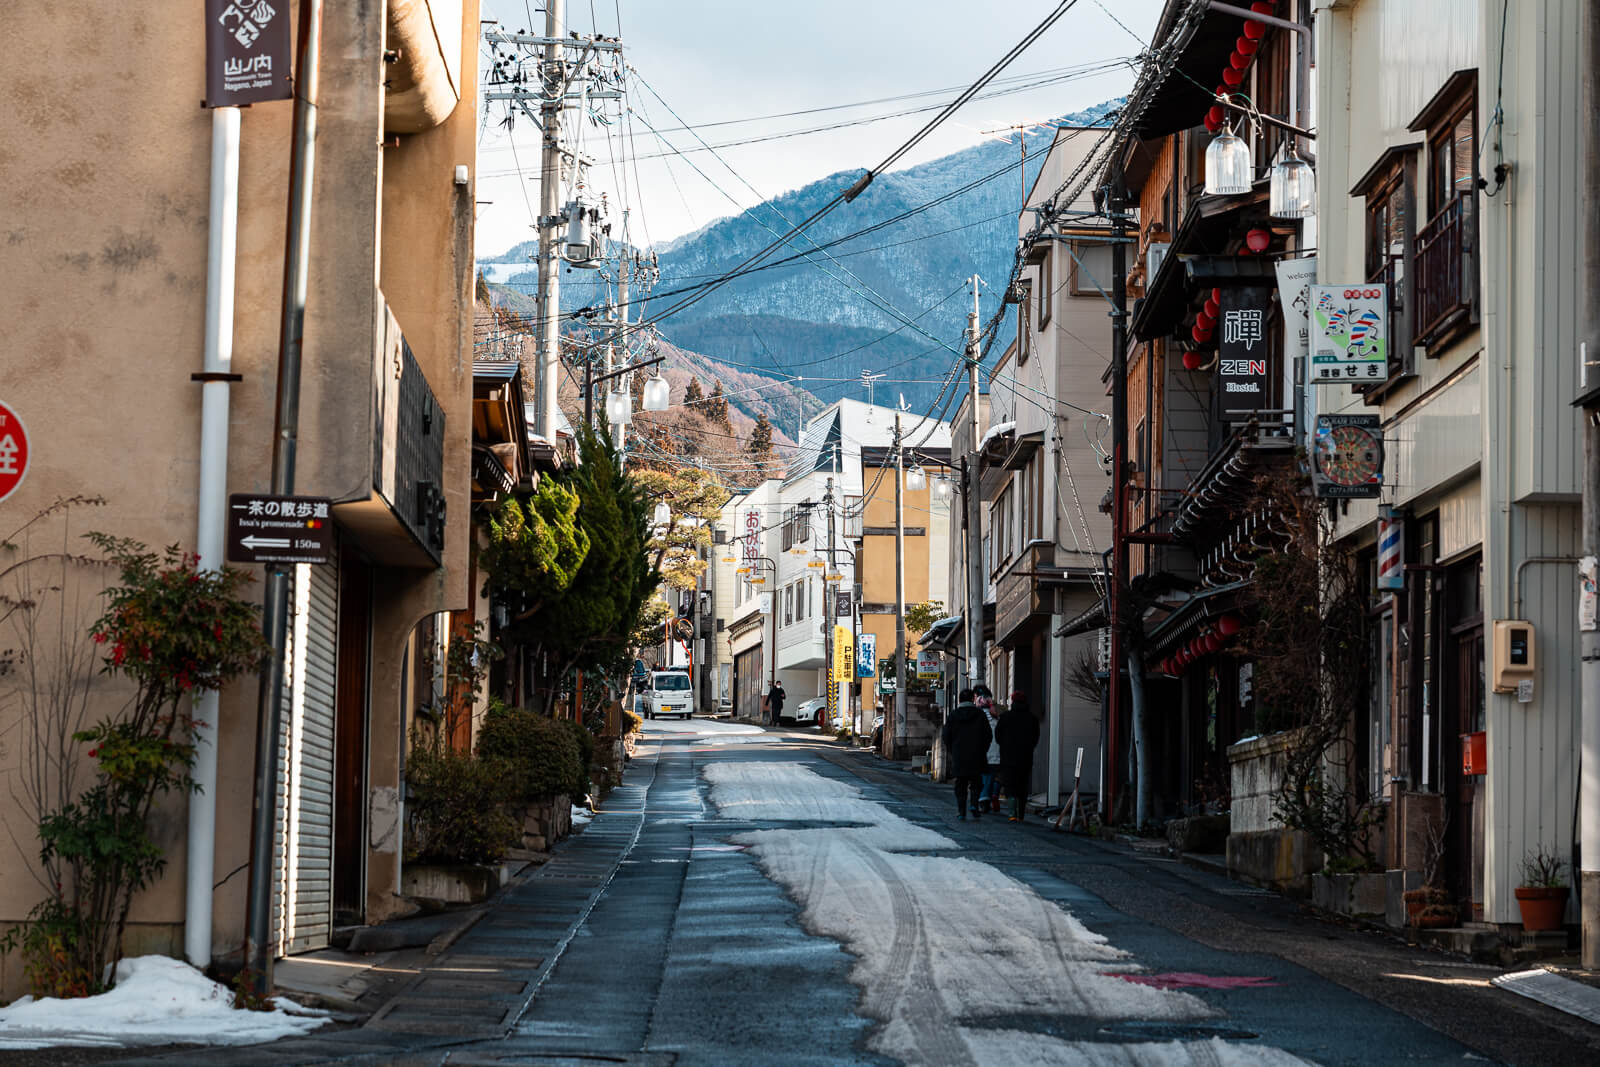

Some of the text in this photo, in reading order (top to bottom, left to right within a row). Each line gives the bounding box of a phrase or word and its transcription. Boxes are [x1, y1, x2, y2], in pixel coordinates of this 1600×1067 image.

[224, 54, 272, 75] 山ノ内
[252, 80, 272, 88] Japan
[1220, 359, 1266, 375] ZEN
[232, 500, 329, 518] 一茶の散歩道
[261, 520, 305, 529] promenade
[294, 539, 321, 549] 150m
